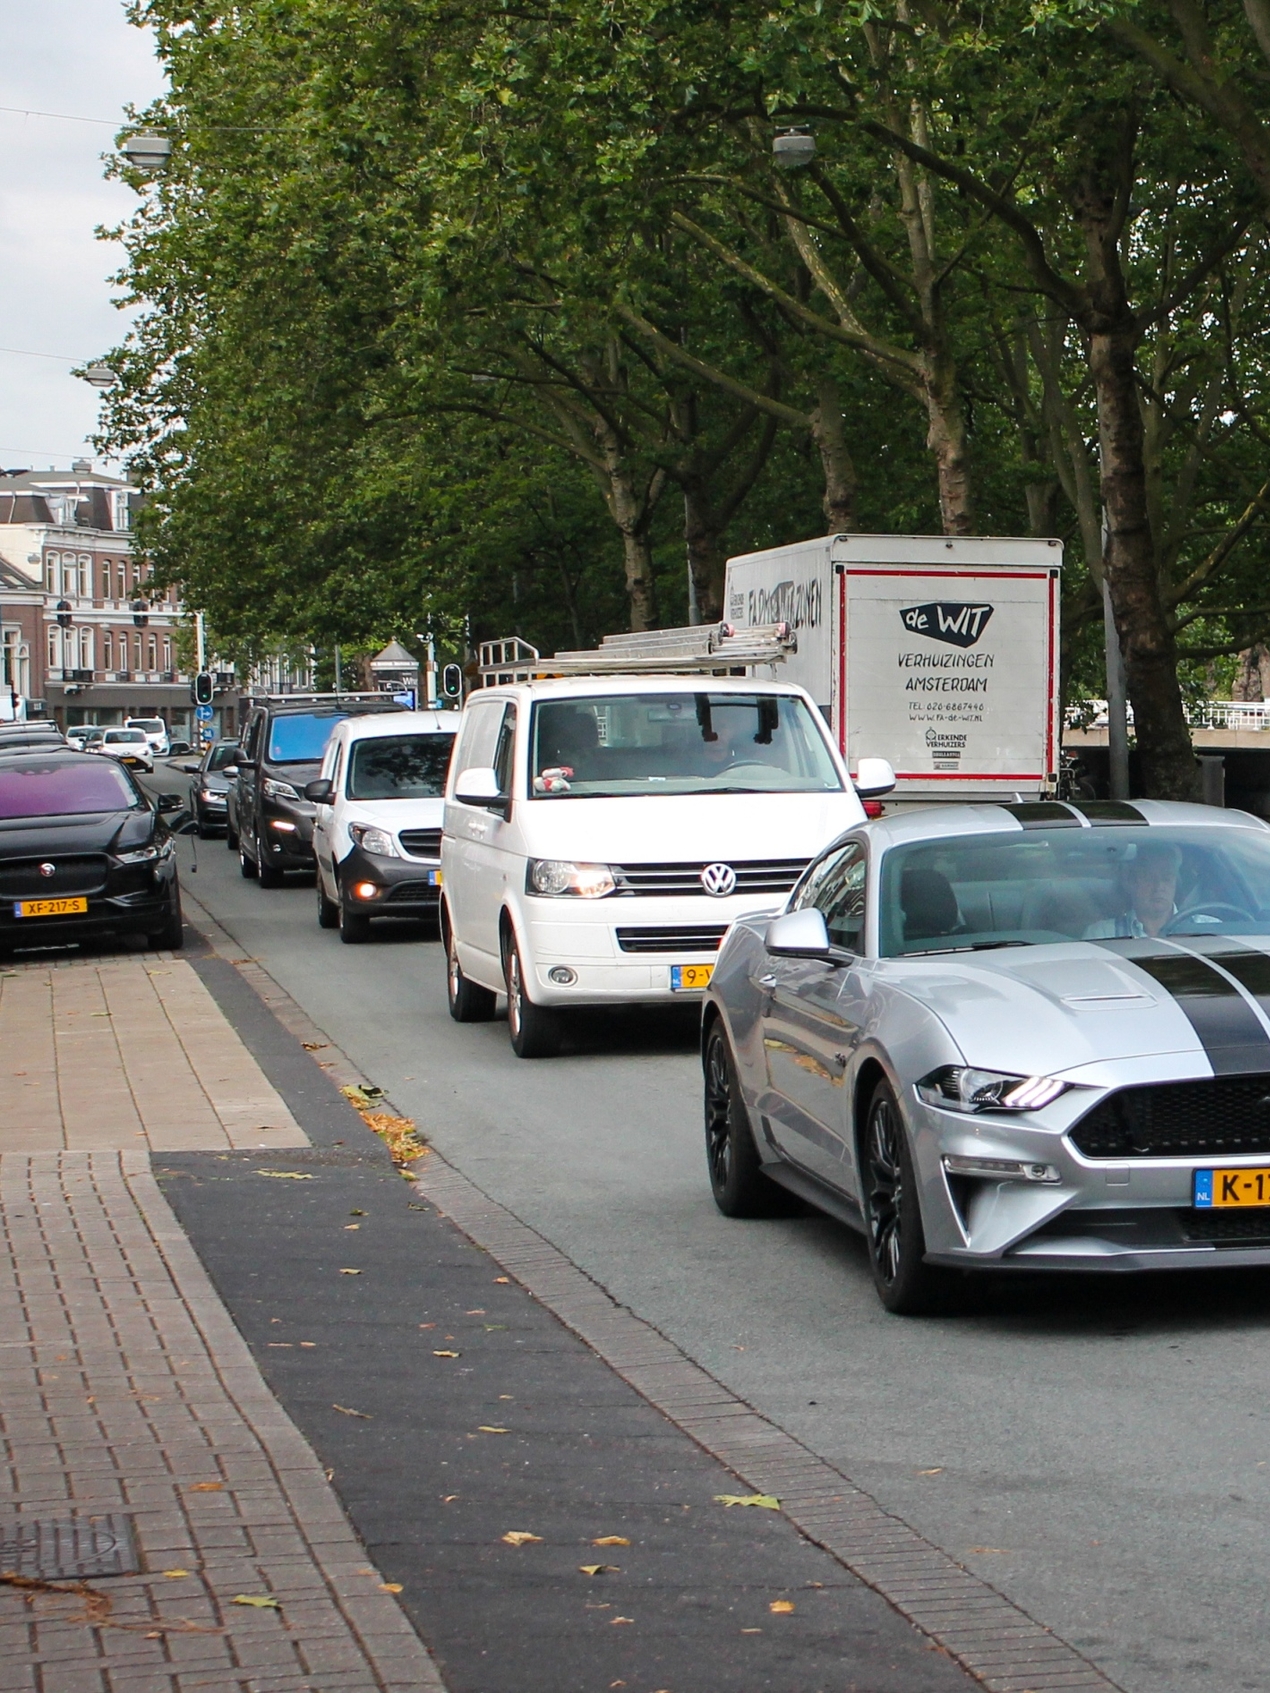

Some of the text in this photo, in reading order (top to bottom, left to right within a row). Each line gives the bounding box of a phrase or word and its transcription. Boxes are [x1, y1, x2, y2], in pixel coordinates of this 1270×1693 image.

[905, 605, 990, 638] de WIT
[898, 653, 995, 669] VERHUIZINGEN
[905, 677, 988, 692] AMSTERDAM
[926, 741, 967, 749] VERHUIZERS
[937, 734, 968, 742] ERKENDE
[28, 900, 80, 915] XF-217-S
[1197, 1192, 1211, 1202] NL
